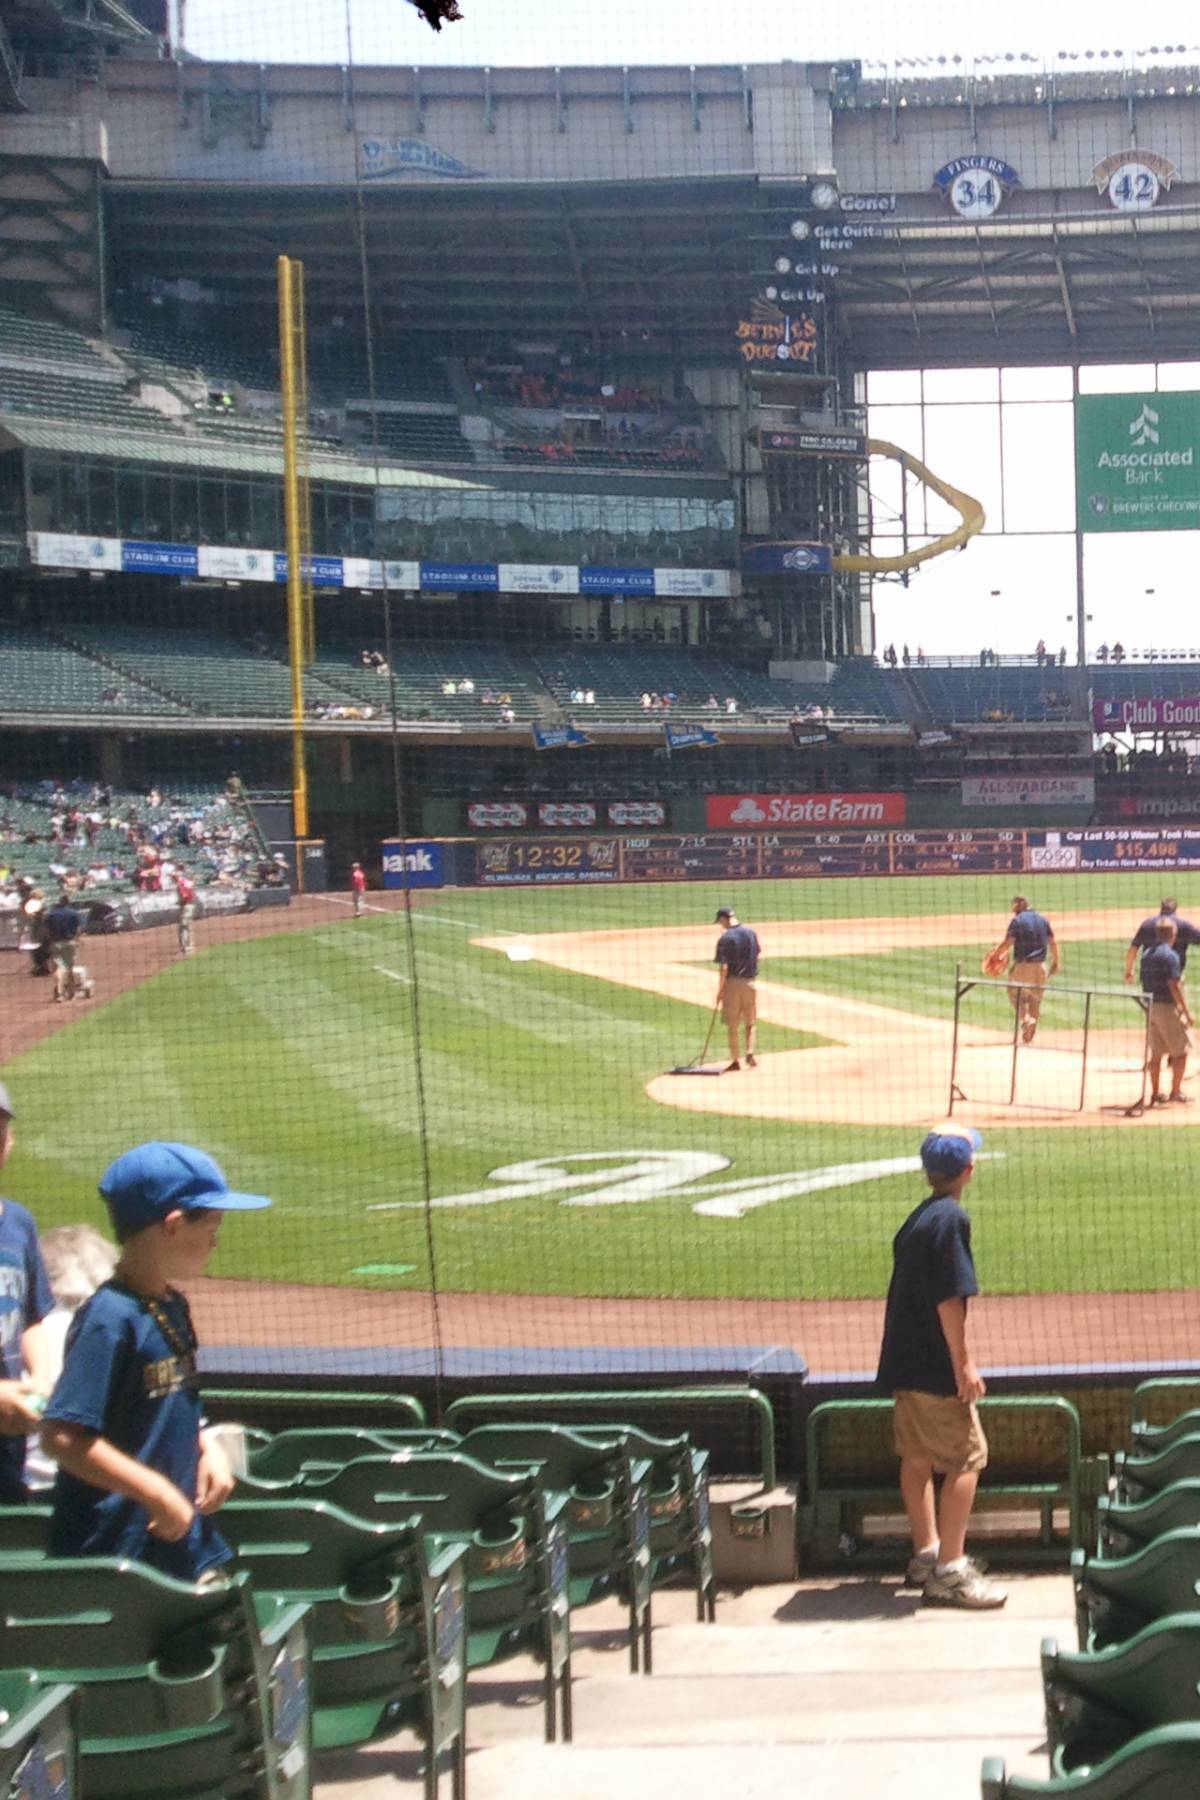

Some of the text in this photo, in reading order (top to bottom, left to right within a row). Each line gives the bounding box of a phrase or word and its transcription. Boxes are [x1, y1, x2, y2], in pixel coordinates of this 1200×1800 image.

[946, 157, 1005, 176] FINGERS
[1114, 173, 1154, 202] 42
[957, 180, 996, 209] 34
[840, 196, 896, 211] Gone!
[814, 225, 882, 238] Get Outta
[820, 239, 853, 250] Here
[795, 264, 839, 277] Get Up
[780, 290, 825, 303] Get Up
[1098, 448, 1193, 468] Associated
[1125, 468, 1164, 485] Bank
[124, 551, 197, 564] STADIUM CLUB
[319, 566, 342, 576] CLUB
[422, 571, 497, 582] STADIUM CLUB
[582, 575, 653, 585] STADIUM CLUB
[1122, 700, 1157, 724] Club
[627, 838, 650, 848] HOU
[732, 836, 755, 847] STL
[764, 835, 780, 847] LA
[896, 833, 917, 843] COL
[998, 831, 1014, 841] SD
[514, 845, 581, 867] 12:32
